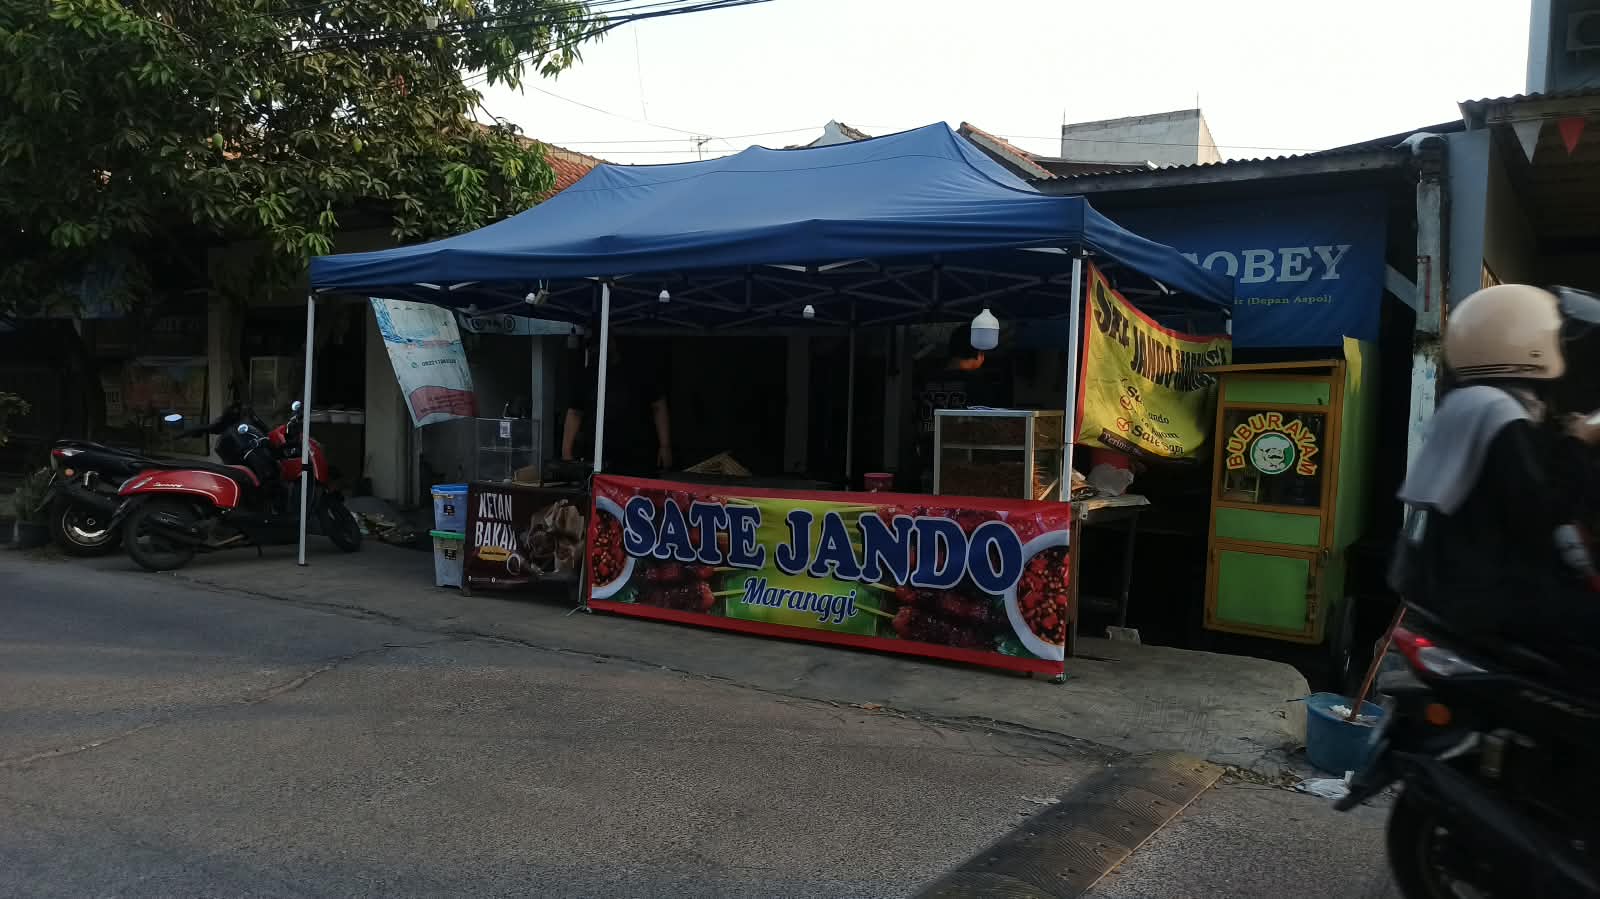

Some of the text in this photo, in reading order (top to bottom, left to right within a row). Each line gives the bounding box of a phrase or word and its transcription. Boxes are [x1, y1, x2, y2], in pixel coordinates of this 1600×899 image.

[1180, 244, 1353, 284] OBEY
[1132, 424, 1160, 447] Sate
[1226, 411, 1319, 476] BUBUR AYAM
[478, 492, 513, 521] KETAN
[624, 496, 1024, 595] SATE JANDO
[741, 576, 858, 625] Maranggi
